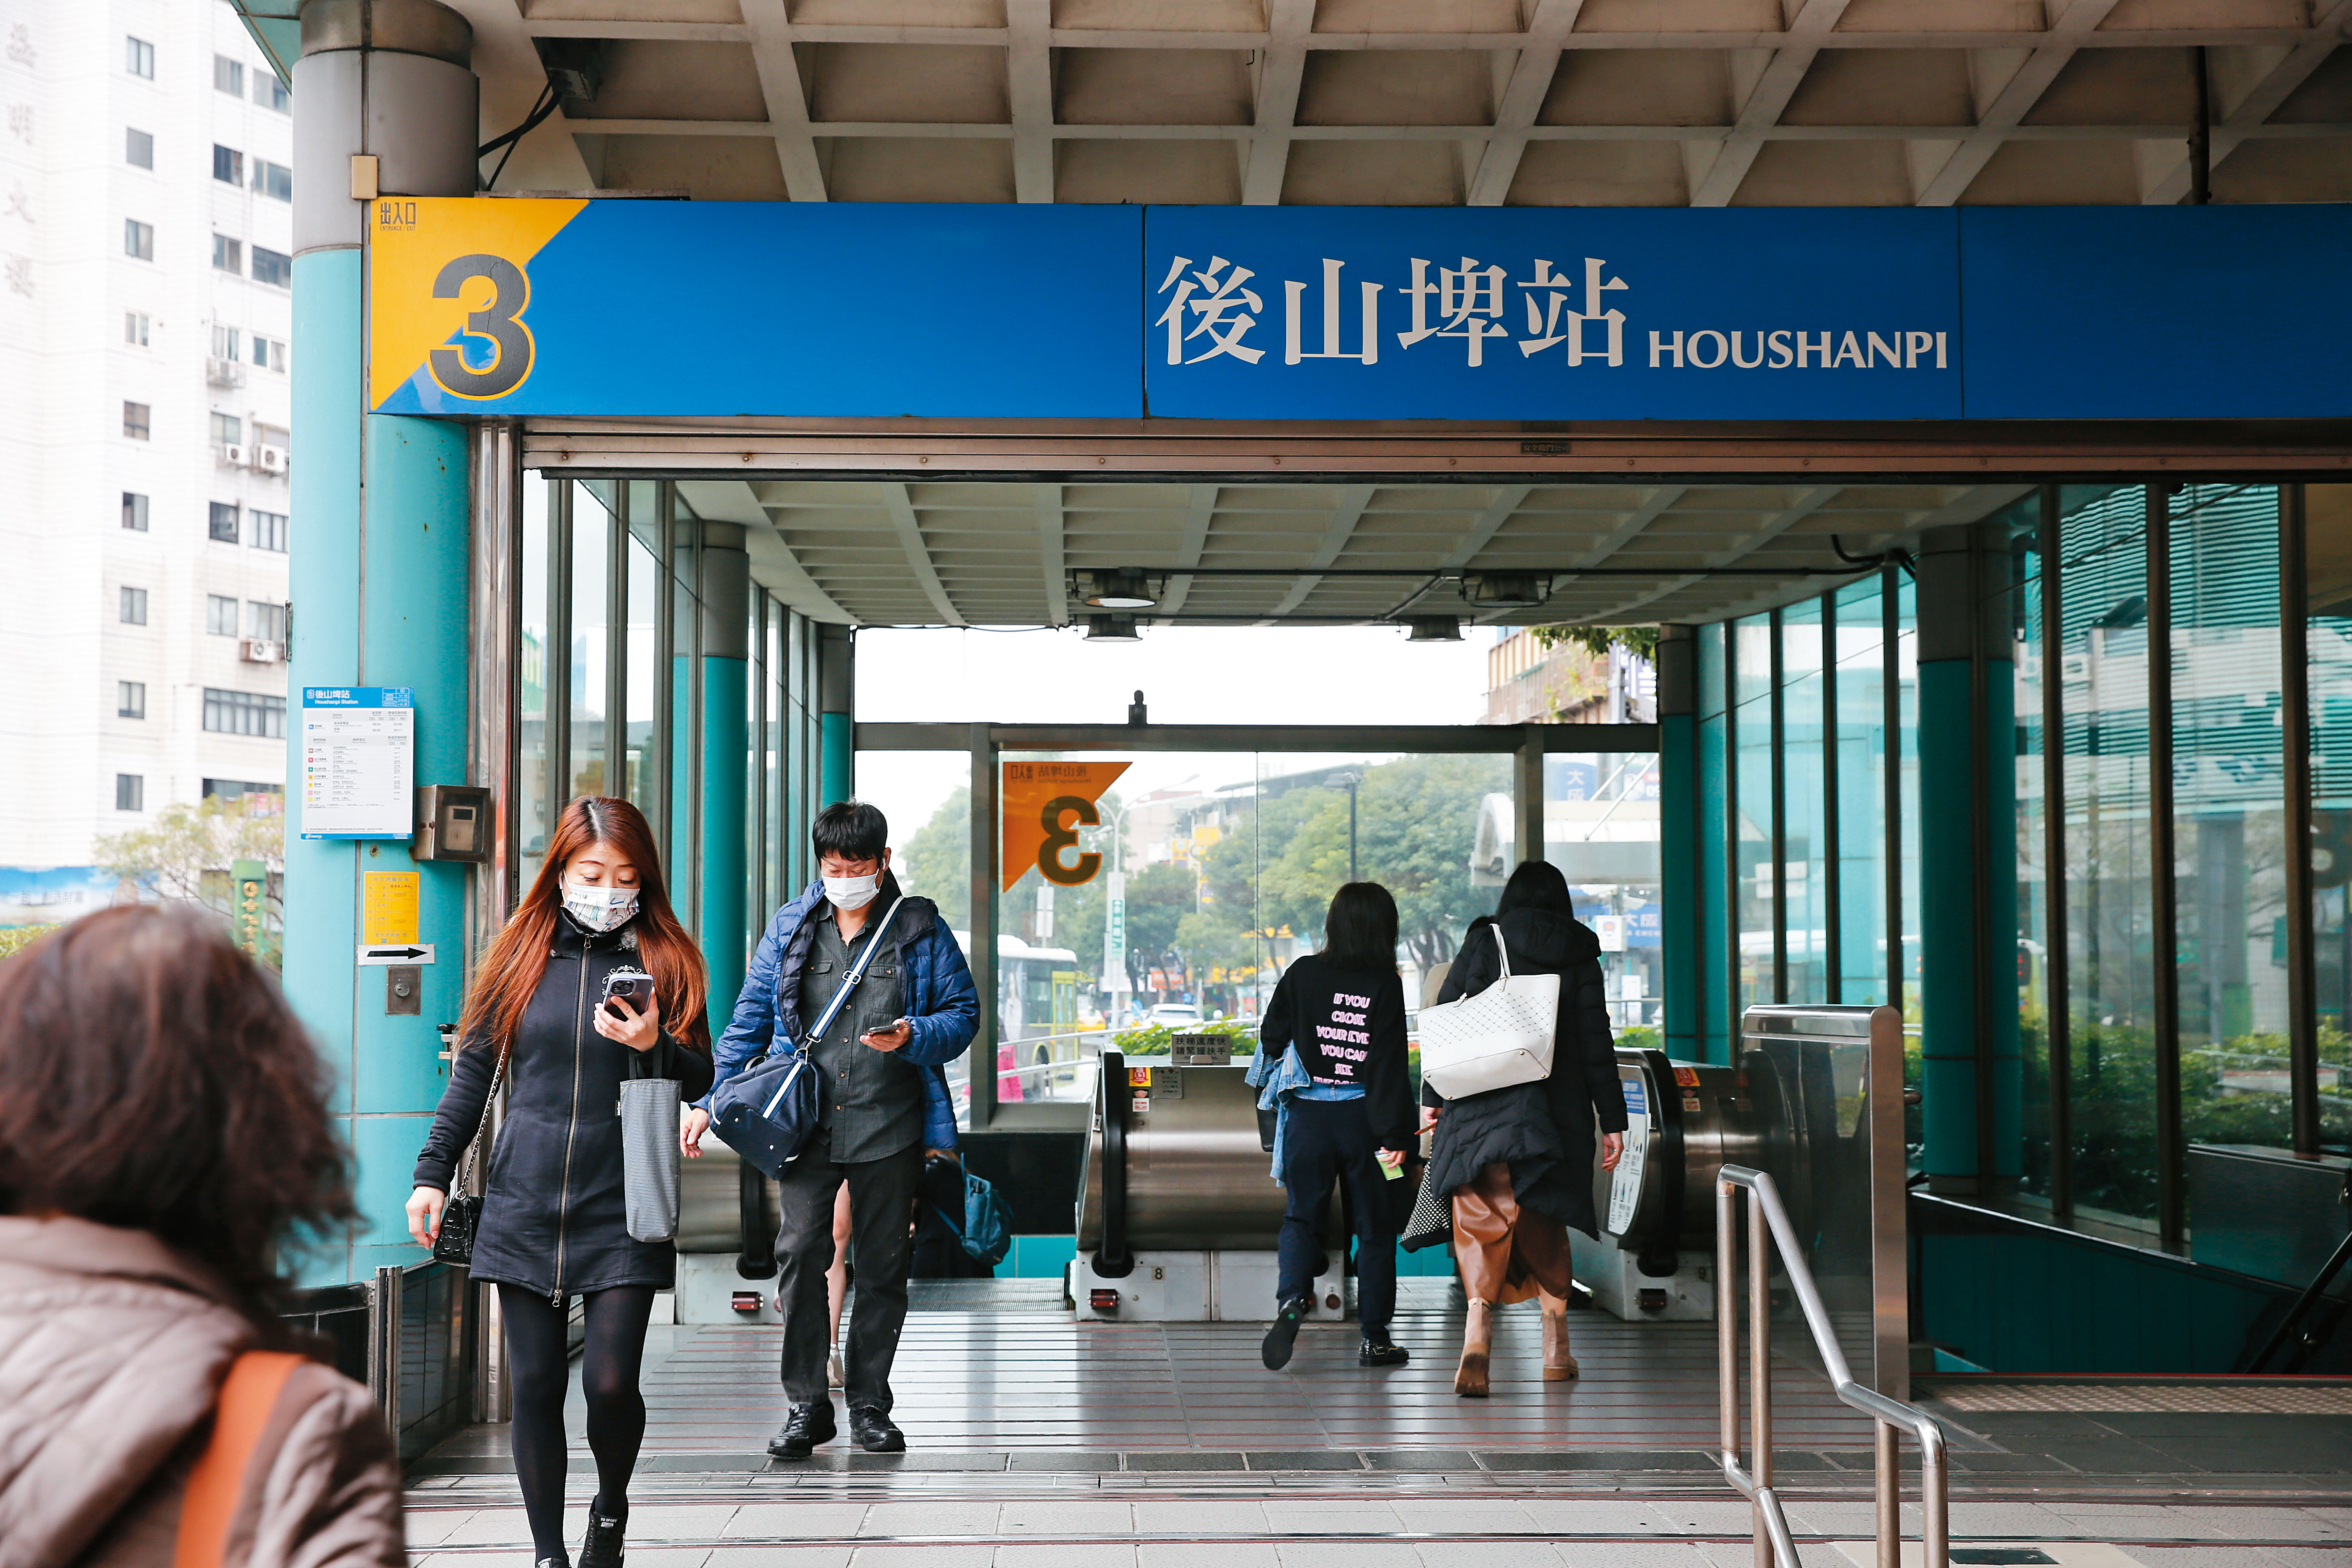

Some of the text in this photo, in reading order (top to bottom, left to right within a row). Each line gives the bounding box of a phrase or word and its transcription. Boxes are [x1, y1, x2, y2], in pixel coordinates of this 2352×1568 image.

[380, 202, 416, 224] 出入口
[1155, 255, 1629, 367] 後山埤站
[430, 254, 530, 396] 3
[1649, 330, 1947, 368] HOUSHANPI
[315, 690, 350, 699] 後山埤站
[1333, 993, 1370, 1009] IF YOU
[1331, 1011, 1366, 1026] CLOSE
[1176, 1037, 1226, 1045] 扶梯速度快
[1316, 1025, 1370, 1045] YOUR EYE
[1176, 1046, 1226, 1055] 請緊握扶手
[1320, 1044, 1368, 1062] YOU CAN
[1334, 1063, 1354, 1076] SEE
[1155, 1268, 1163, 1280] 8
